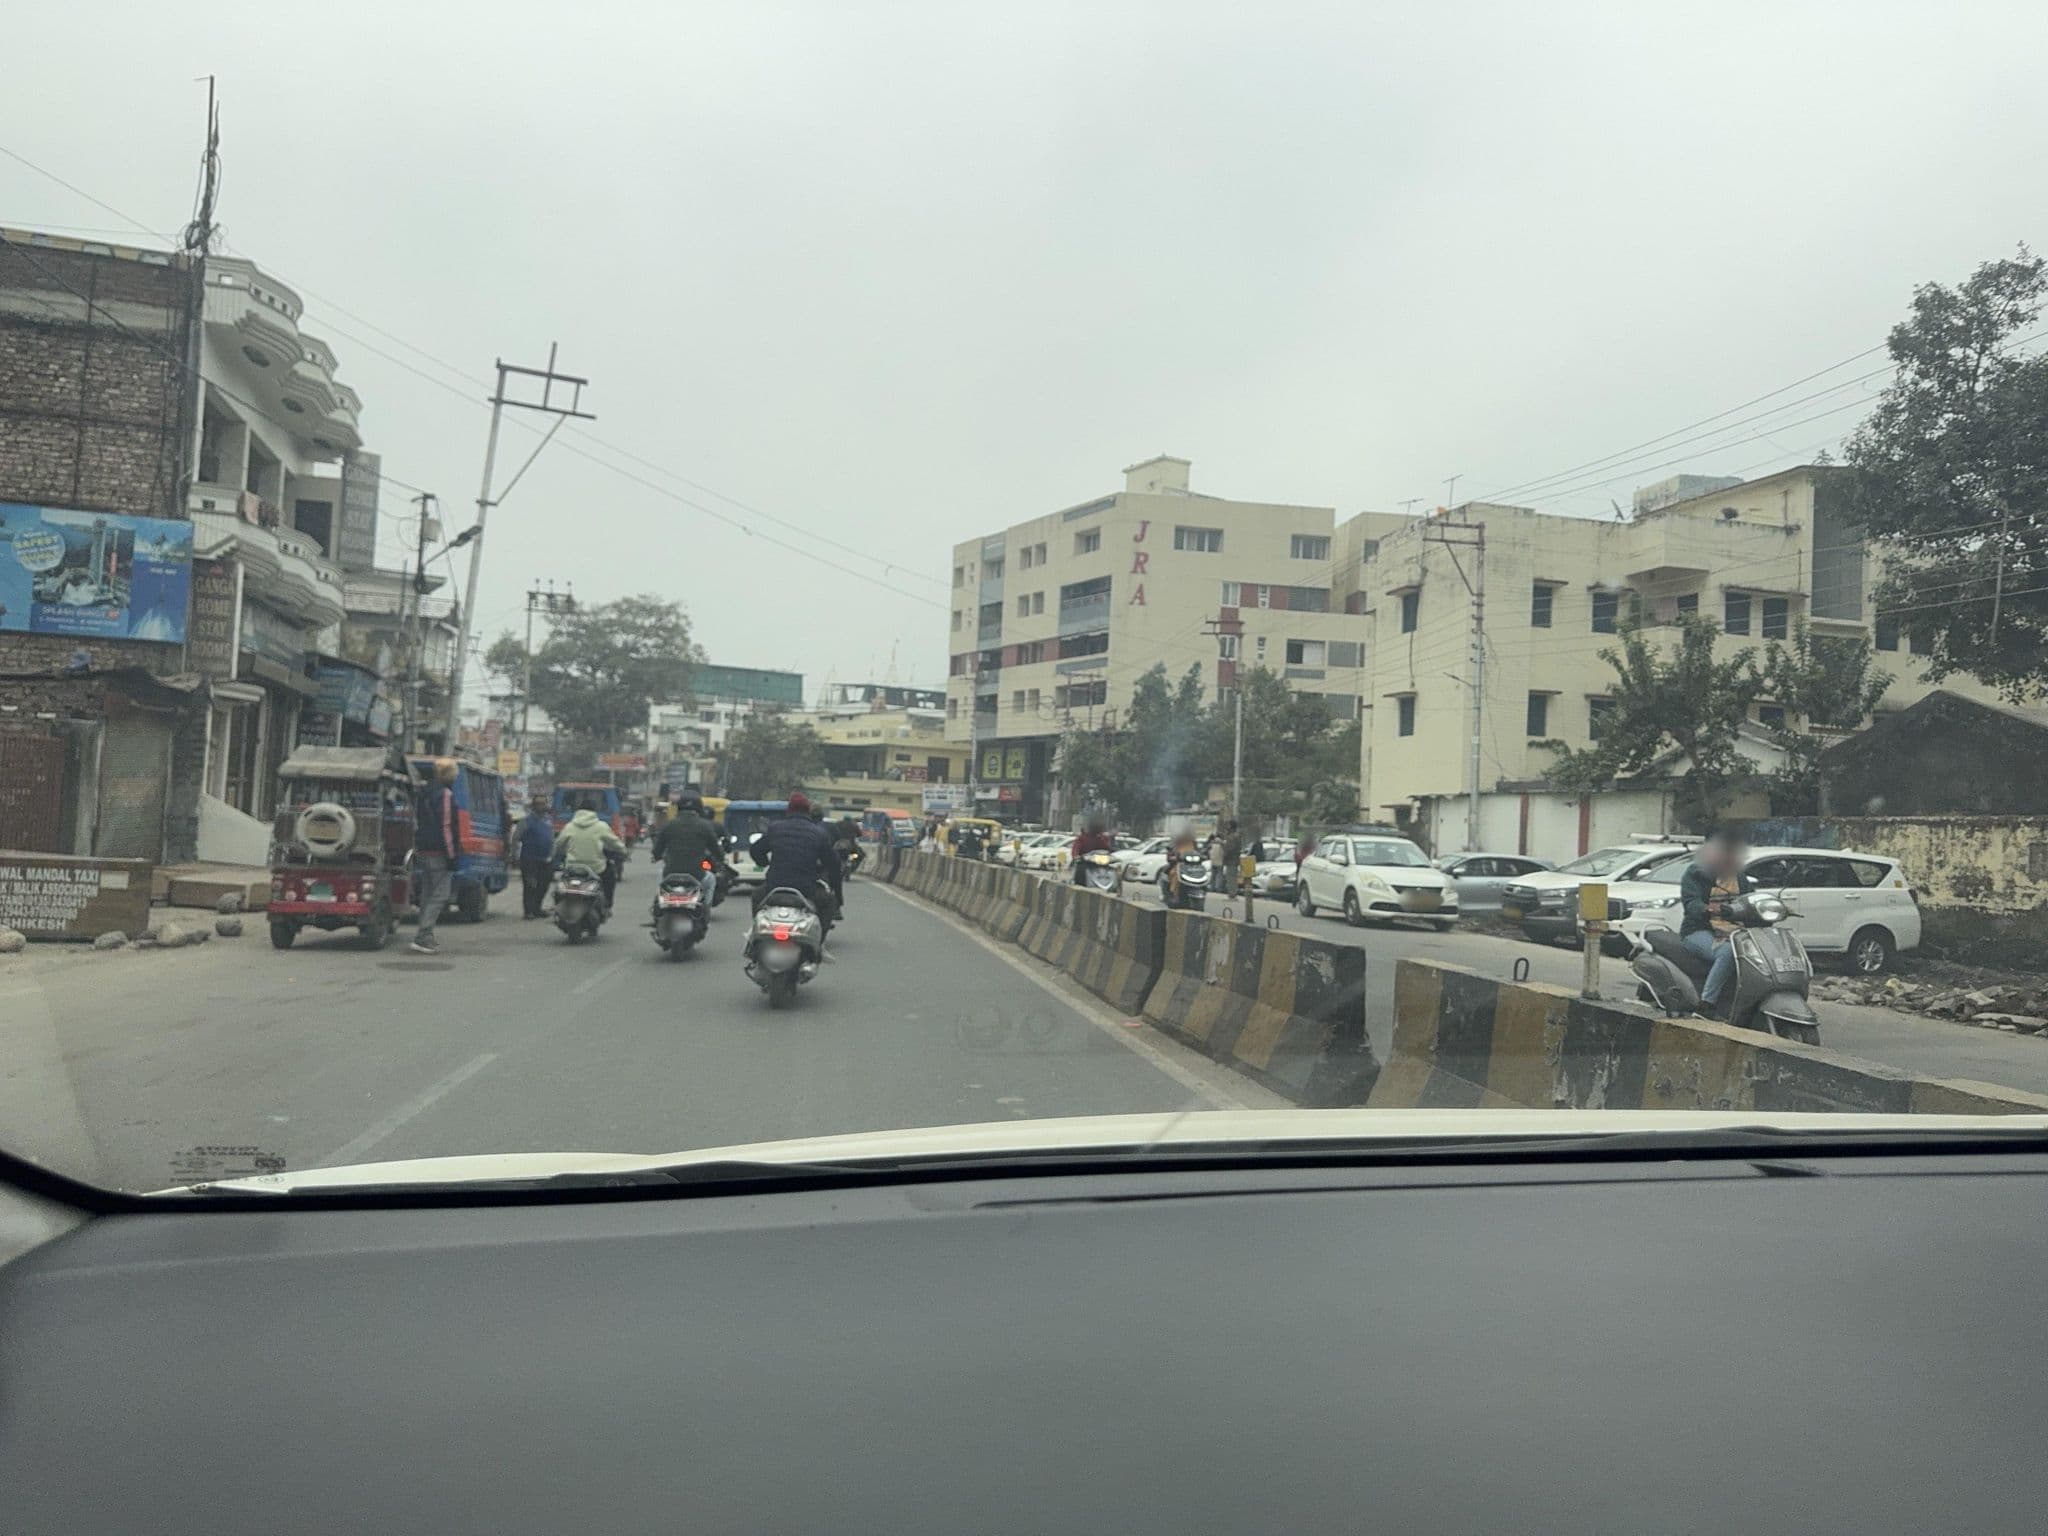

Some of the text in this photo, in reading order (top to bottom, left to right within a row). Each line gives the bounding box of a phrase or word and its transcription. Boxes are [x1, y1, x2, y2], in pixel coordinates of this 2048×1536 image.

[1129, 519, 1152, 606] JRA
[26, 867, 71, 882] MANDAL
[74, 869, 99, 882] TAXI
[42, 882, 98, 897] ASSOCIATION
